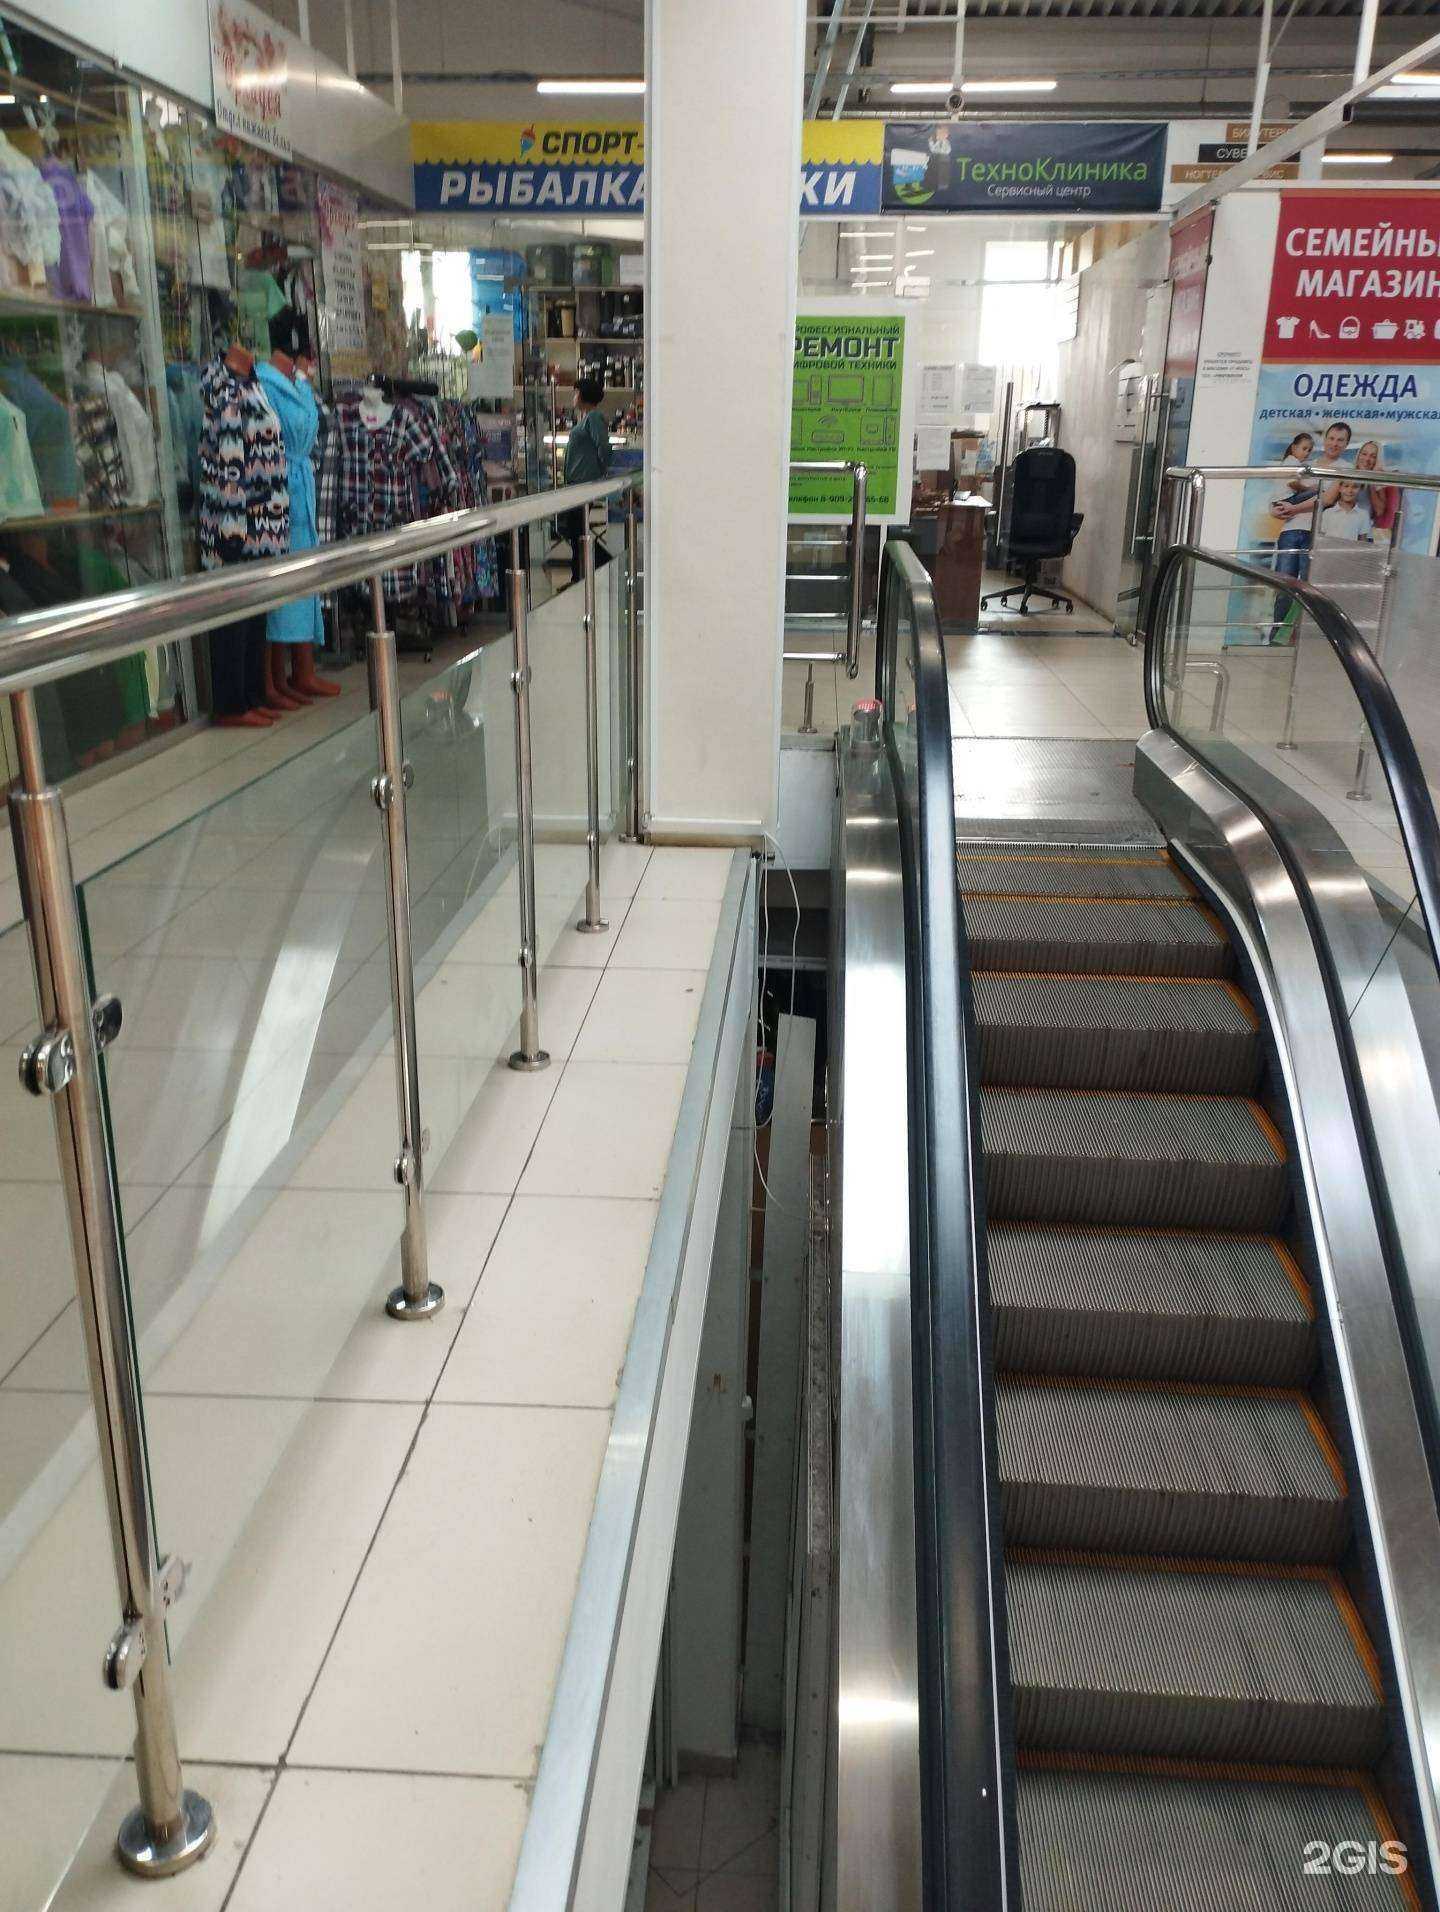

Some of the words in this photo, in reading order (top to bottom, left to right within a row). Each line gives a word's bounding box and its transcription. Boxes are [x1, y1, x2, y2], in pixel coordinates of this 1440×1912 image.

[542, 131, 644, 155] СПОРТ-
[1216, 147, 1248, 159] СУВЕ
[957, 156, 1148, 182] ТехноКлиника
[440, 170, 644, 206] РЫБАЛКА
[800, 171, 856, 205] КИ
[987, 183, 1053, 200] Сервисный
[1056, 185, 1092, 199] центр
[1295, 269, 1440, 298] МАГАЗИН
[796, 325, 900, 335] РОФЕССИОНАЛЬНЫЙ
[794, 360, 845, 369] ИФРОВОЙ
[1294, 373, 1419, 402] ОДЕЖДА
[1259, 408, 1312, 419] детская
[1321, 408, 1381, 419] женская
[1386, 409, 1440, 422] мужска
